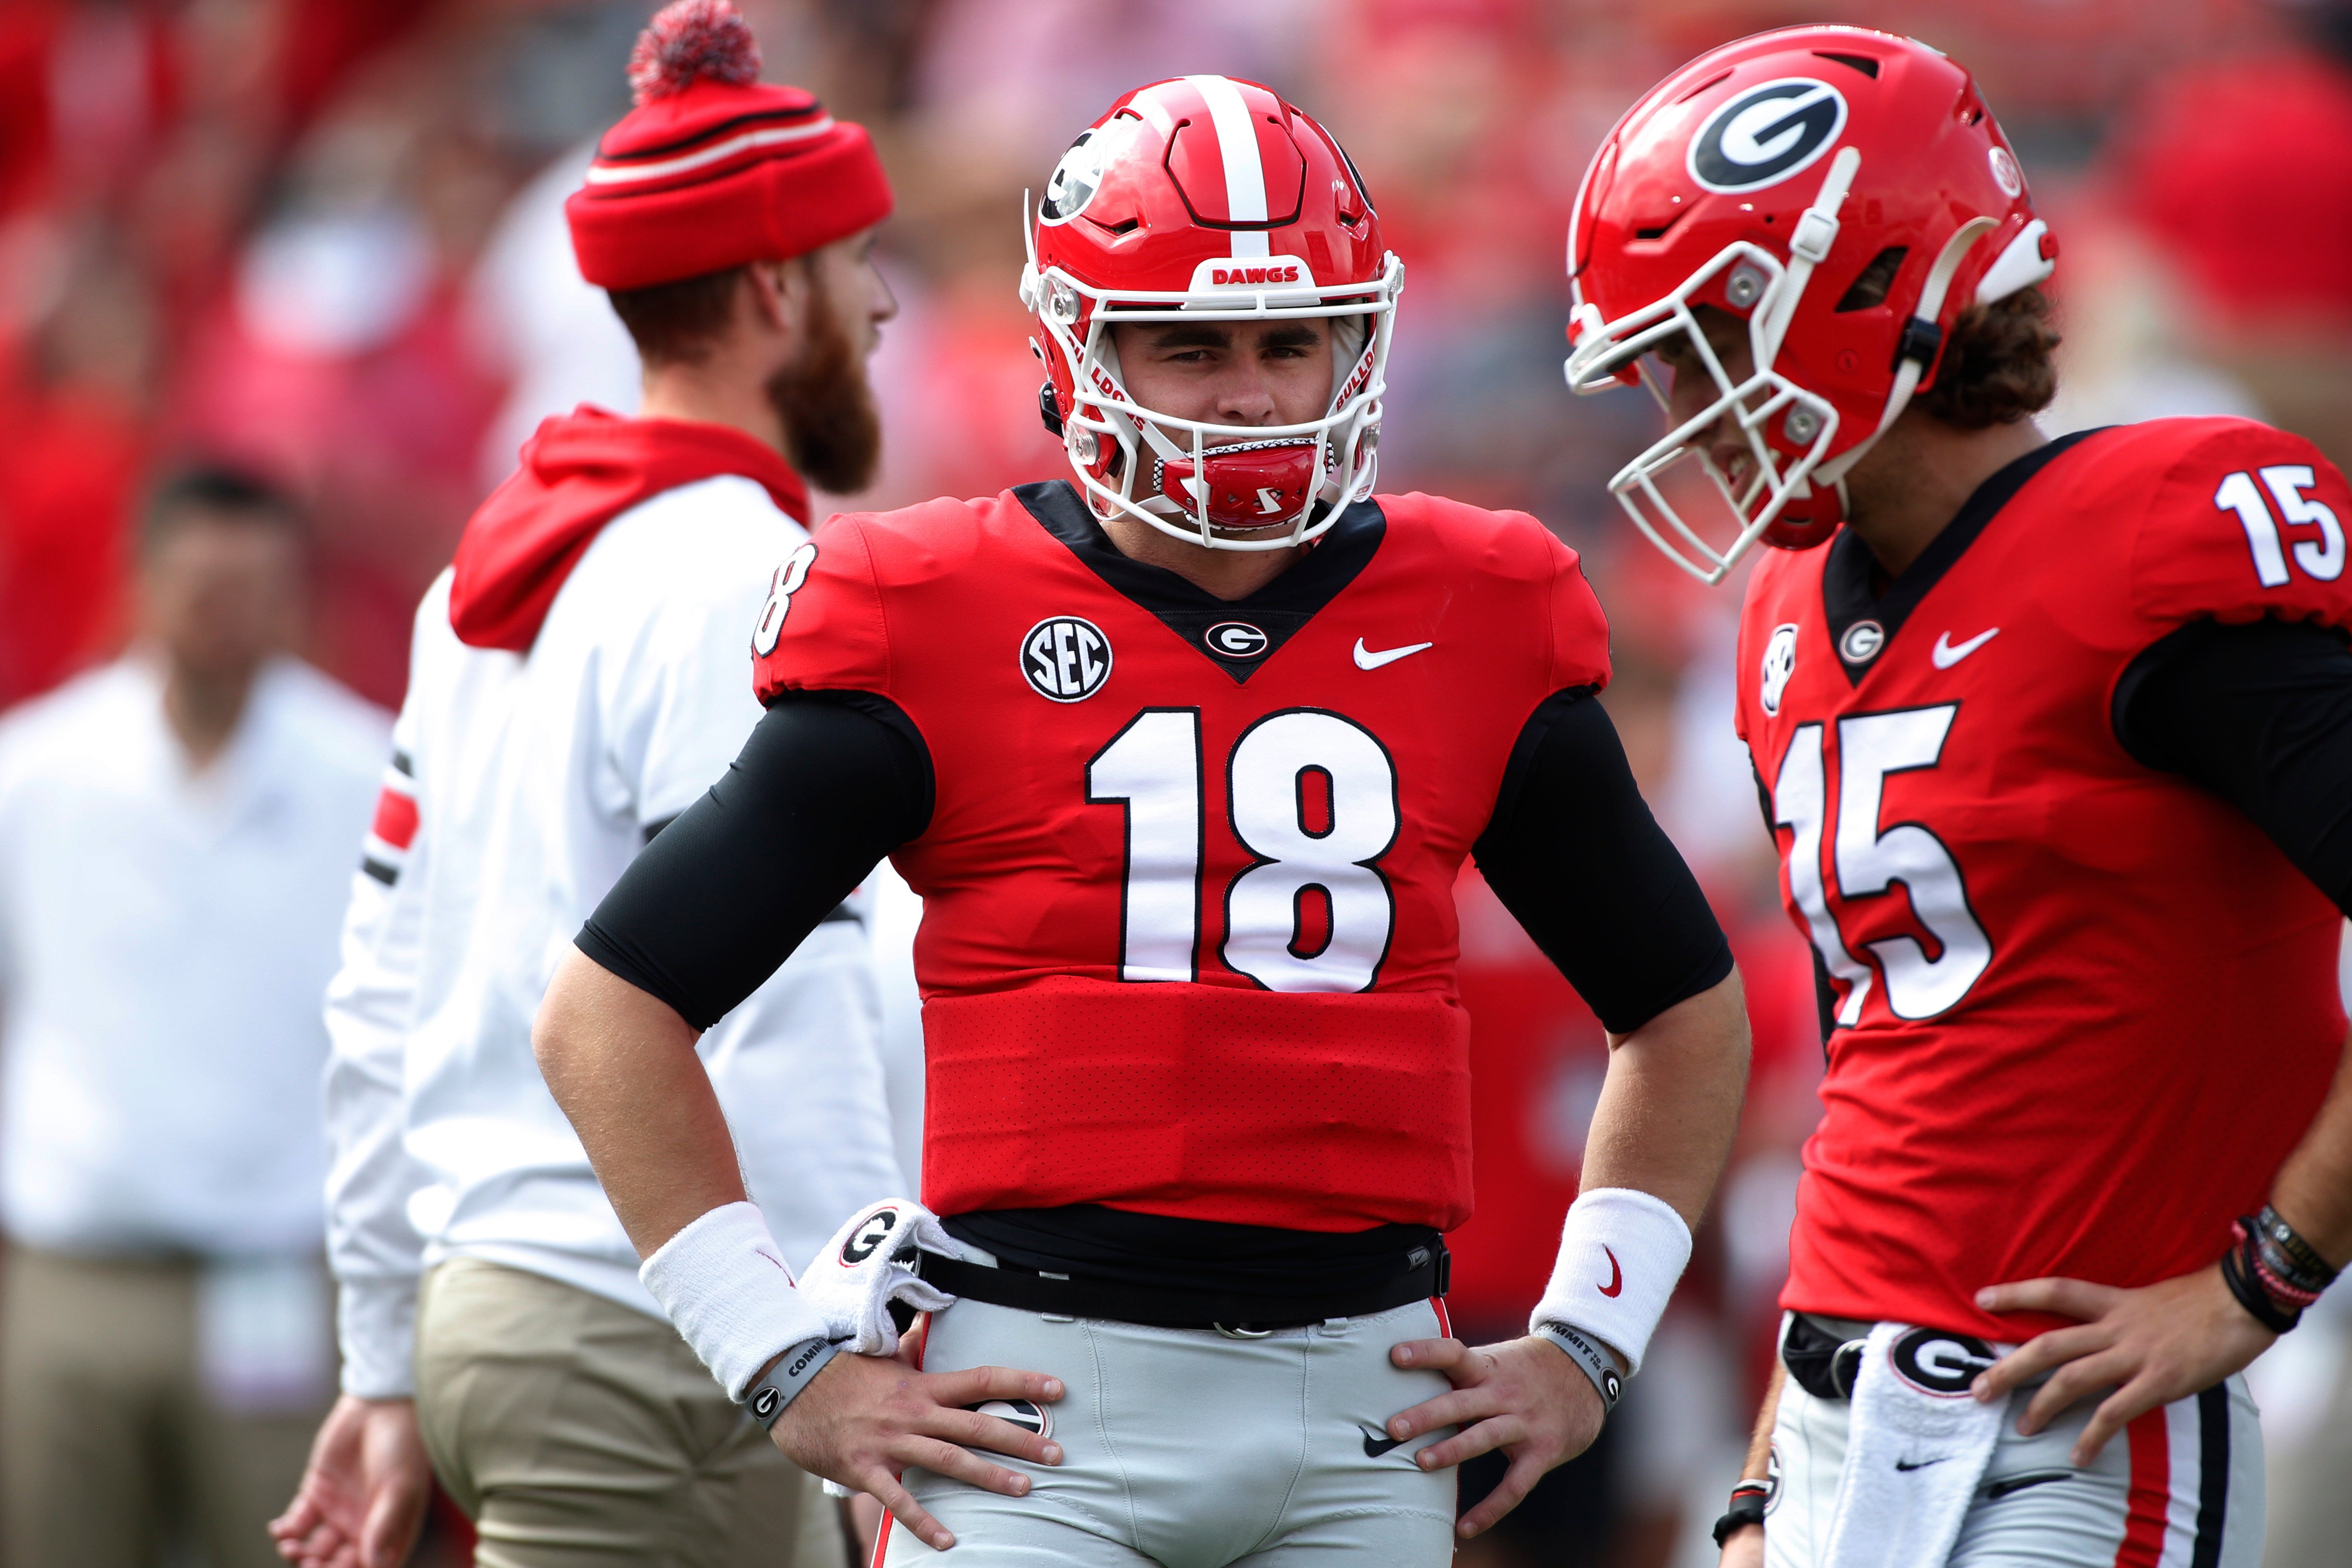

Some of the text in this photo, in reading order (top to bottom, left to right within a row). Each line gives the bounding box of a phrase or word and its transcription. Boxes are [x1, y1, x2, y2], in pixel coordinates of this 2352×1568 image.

[1212, 266, 1299, 285] DAWGS
[1067, 335, 1146, 431] ULDOS
[1336, 341, 1376, 412] BULLD
[2214, 464, 2346, 588] 15
[751, 543, 819, 658] 8
[1029, 623, 1104, 695] SEC
[1085, 706, 1401, 993] 18
[1774, 700, 1994, 1028] 15
[1590, 1356, 1602, 1371] THE
[1594, 1353, 1602, 1364] TO
